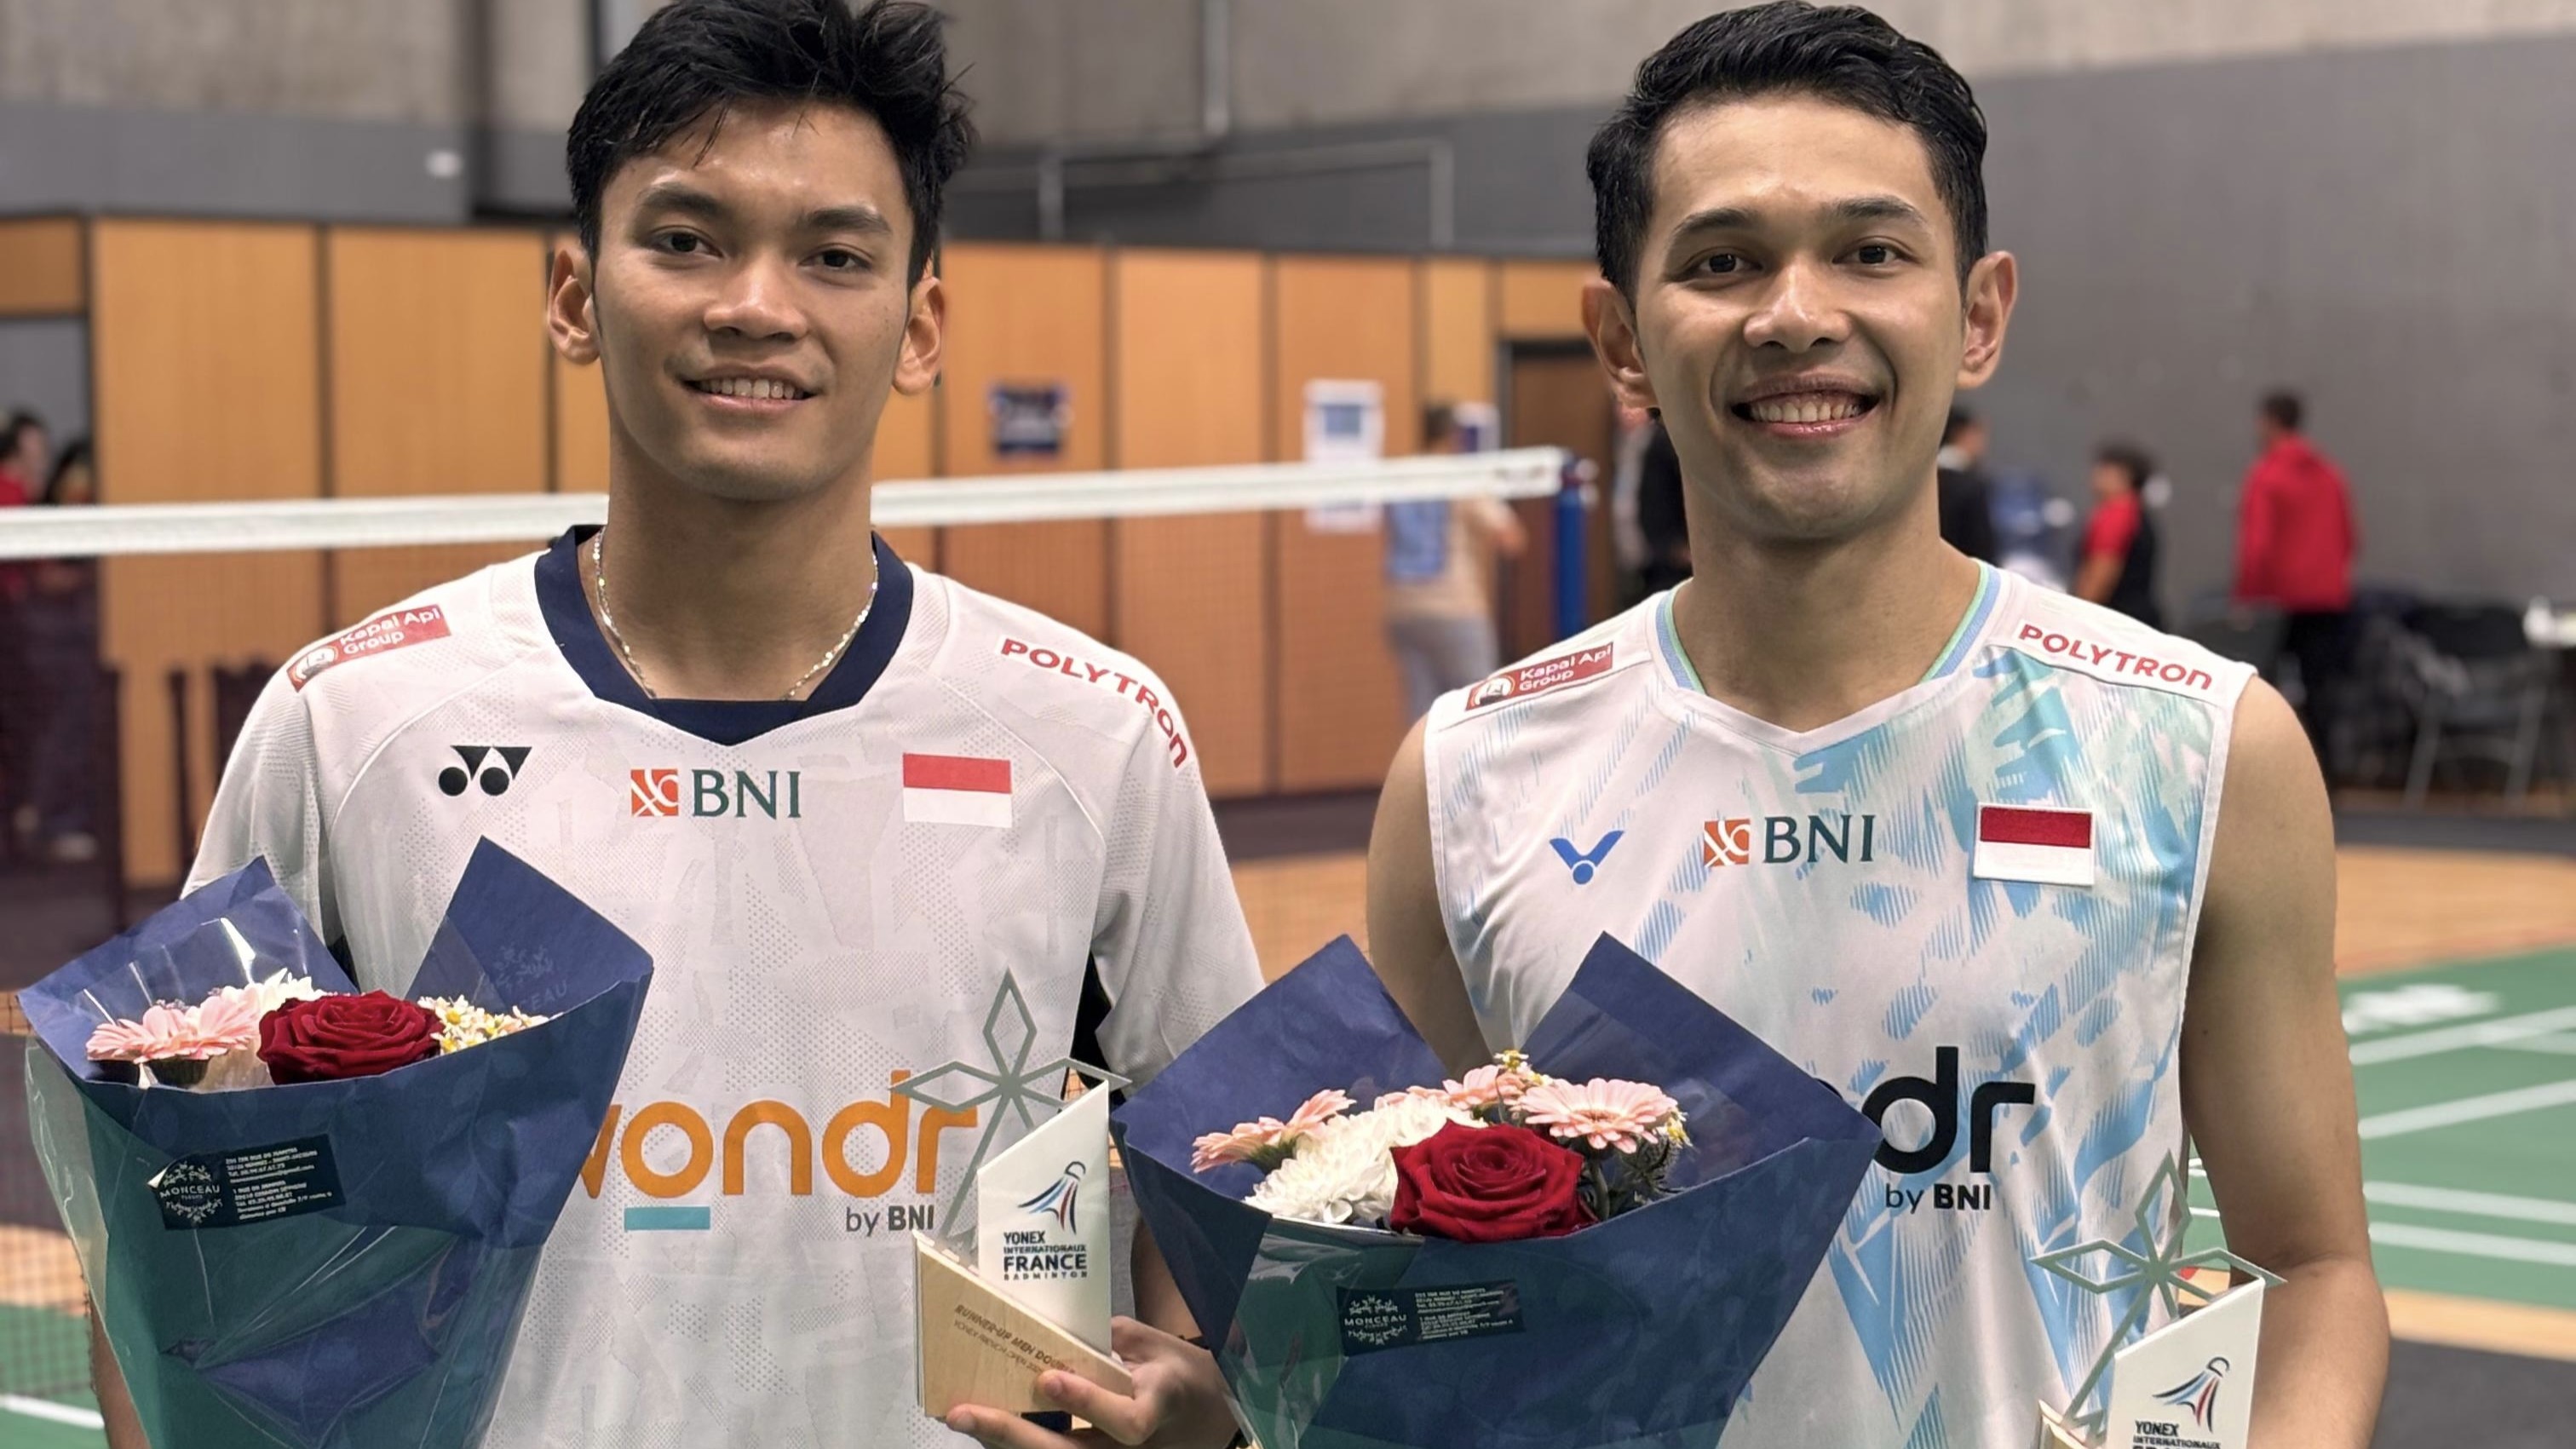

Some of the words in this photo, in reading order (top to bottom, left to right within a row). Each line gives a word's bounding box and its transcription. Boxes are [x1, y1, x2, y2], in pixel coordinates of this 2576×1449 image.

[340, 614, 401, 647] Kapal
[404, 607, 440, 625] Api
[343, 630, 405, 655] Group
[1521, 656, 1575, 681] Kapal
[1578, 645, 1611, 664] Api
[1519, 670, 1574, 692] Group
[692, 769, 802, 820] BNI
[1763, 814, 1877, 864] BNI
[158, 1184, 221, 1199] MONCEAU
[1884, 1182, 1925, 1215] by
[1933, 1183, 1991, 1210] BNI
[845, 1206, 881, 1237] by
[888, 1205, 934, 1231] BNI
[1003, 1231, 1046, 1245] YONEX
[1003, 1244, 1087, 1255] INTERNATIONAUX
[1003, 1254, 1088, 1273] FRANCE
[1003, 1271, 1088, 1281] BADMINTON
[954, 1304, 1013, 1340] RUNNER-UP
[1010, 1337, 1037, 1355] MEN
[1343, 1314, 1407, 1326] MONCEAU
[2135, 1420, 2180, 1437] YONEX
